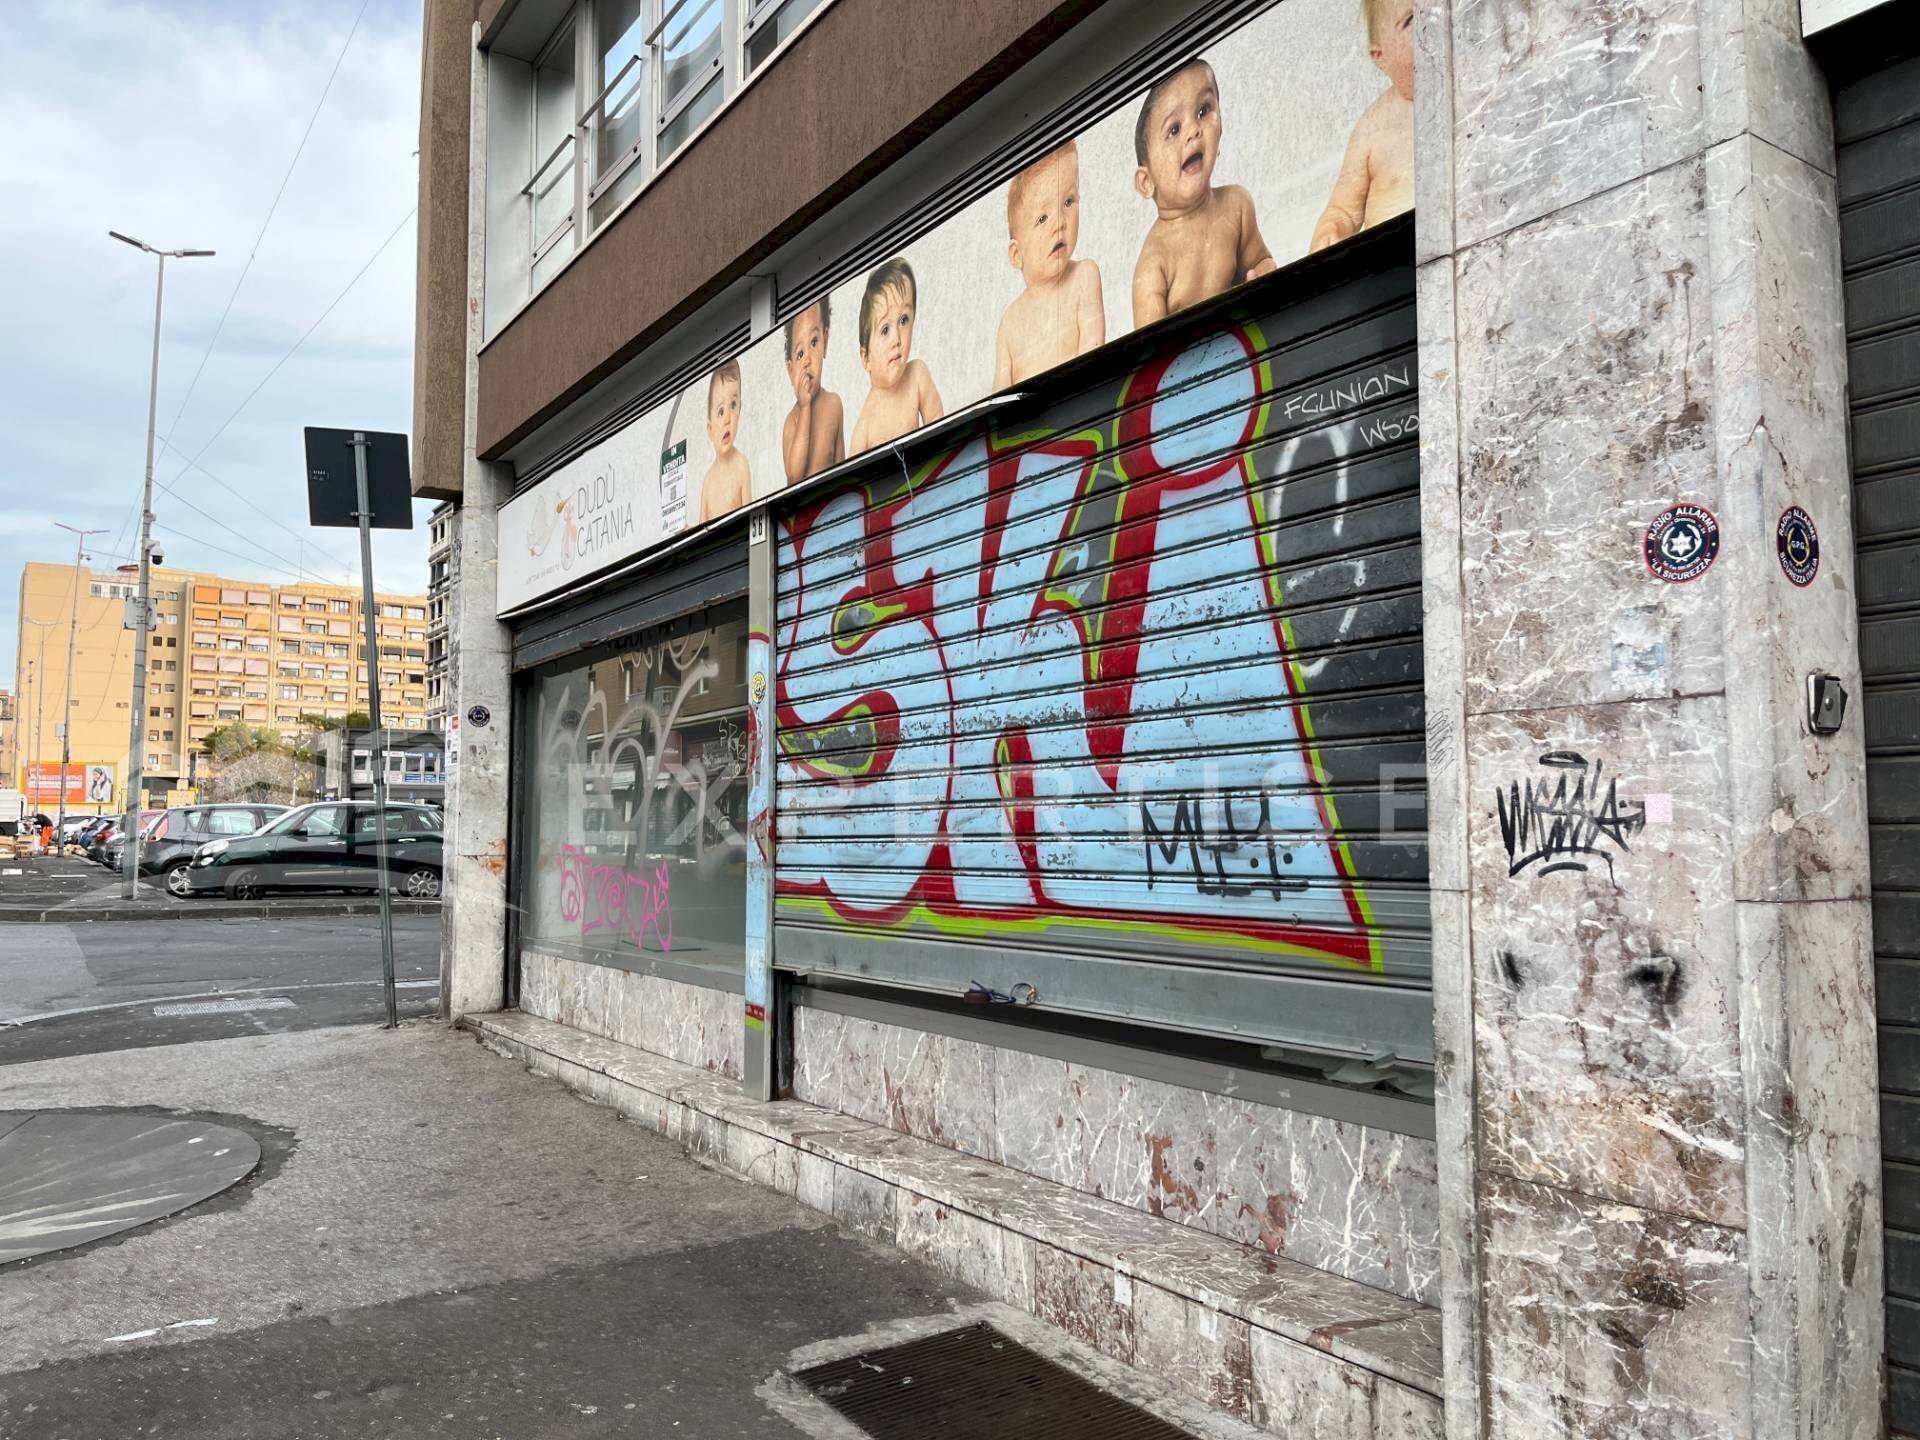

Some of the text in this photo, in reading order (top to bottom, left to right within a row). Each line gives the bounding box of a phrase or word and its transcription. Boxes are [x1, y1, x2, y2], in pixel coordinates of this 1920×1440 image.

[662, 454, 685, 473] VENDITA
[577, 463, 615, 519] DUDÙ
[577, 503, 634, 557] CATANIA
[752, 514, 763, 537] 56
[1676, 507, 1717, 532] ALLARME
[1793, 509, 1817, 542] ALLARME
